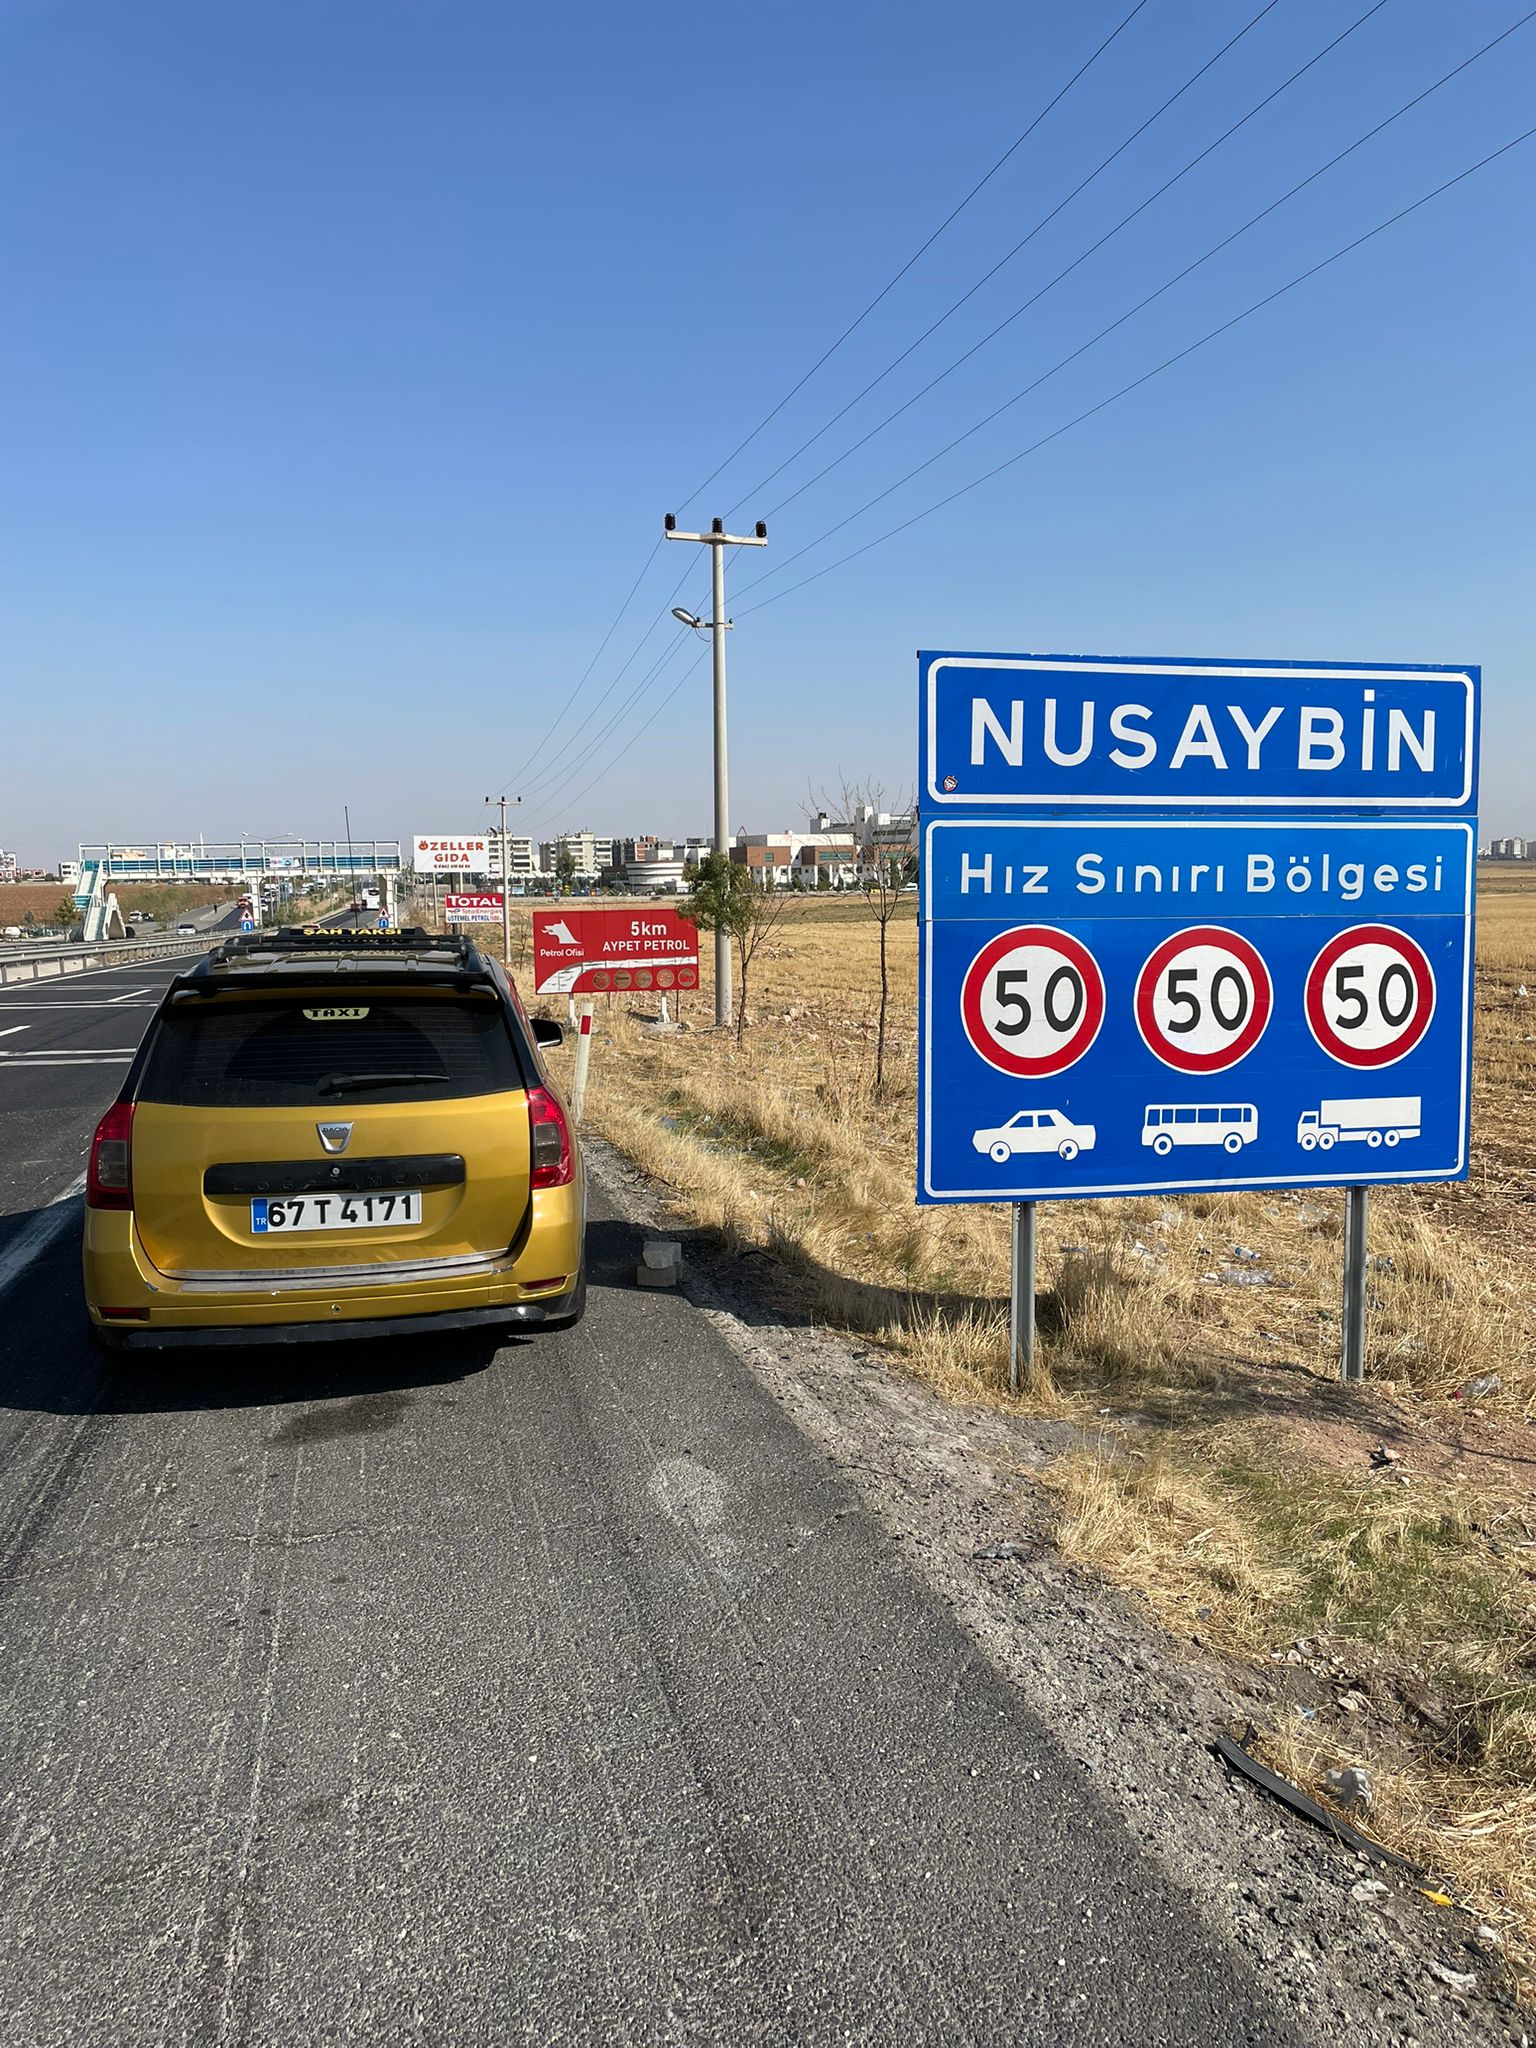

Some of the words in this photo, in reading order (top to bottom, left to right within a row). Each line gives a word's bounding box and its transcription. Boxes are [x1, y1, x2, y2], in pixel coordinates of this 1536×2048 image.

[970, 689, 1437, 772] NUSAYBİN
[418, 840, 484, 851] ÖZELLER
[960, 852, 1049, 895] Hız
[1076, 853, 1225, 894] Sınırı
[1246, 852, 1444, 900] Bölgesi
[540, 949, 564, 957] Petrol
[565, 948, 585, 957] Ofisi
[602, 941, 641, 952] AYPET
[643, 940, 690, 950] PETROL
[310, 1009, 361, 1018] TAXI
[994, 965, 1084, 1036] 50
[1167, 965, 1249, 1033] 50
[1335, 963, 1415, 1031] 50
[256, 1217, 267, 1225] TR
[267, 1201, 304, 1226] 67
[314, 1199, 331, 1224] T
[340, 1195, 412, 1222] 4171
